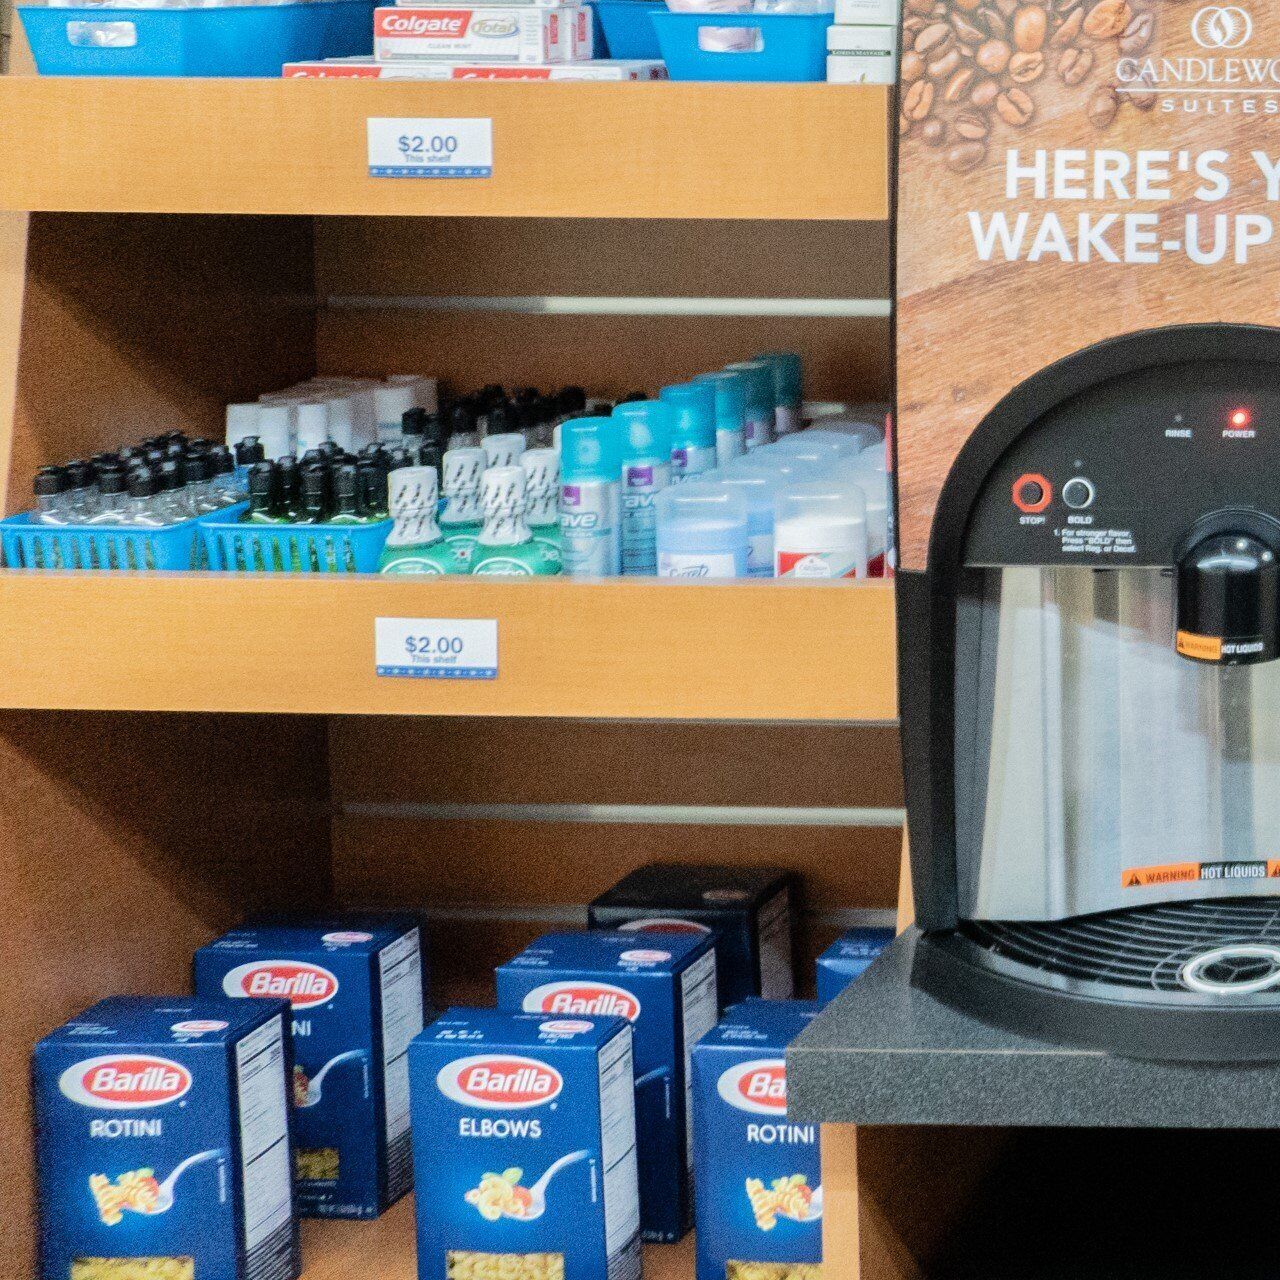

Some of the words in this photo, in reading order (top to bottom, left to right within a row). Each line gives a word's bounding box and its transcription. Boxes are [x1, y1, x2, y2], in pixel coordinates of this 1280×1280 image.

[382, 15, 461, 35] Colgate
[471, 20, 519, 36] Total
[1160, 100, 1279, 113] SUITES
[398, 135, 458, 154] $2.00
[1004, 148, 1231, 202] HERE'S
[967, 211, 1273, 266] WAKE-UP
[1165, 430, 1192, 438] RINSE
[1222, 430, 1256, 438] POWER
[1067, 516, 1093, 525] BOLD
[405, 635, 464, 655] $2.00
[1145, 870, 1195, 883] WARNING
[1200, 867, 1222, 879] HOT
[1225, 866, 1265, 878] LIQUIDS
[250, 972, 328, 995] Barilla
[91, 1068, 181, 1092] Barilla
[89, 1119, 161, 1138] ROTINI
[459, 1118, 542, 1138] ELBOWS
[747, 1124, 814, 1144] ROTINI
